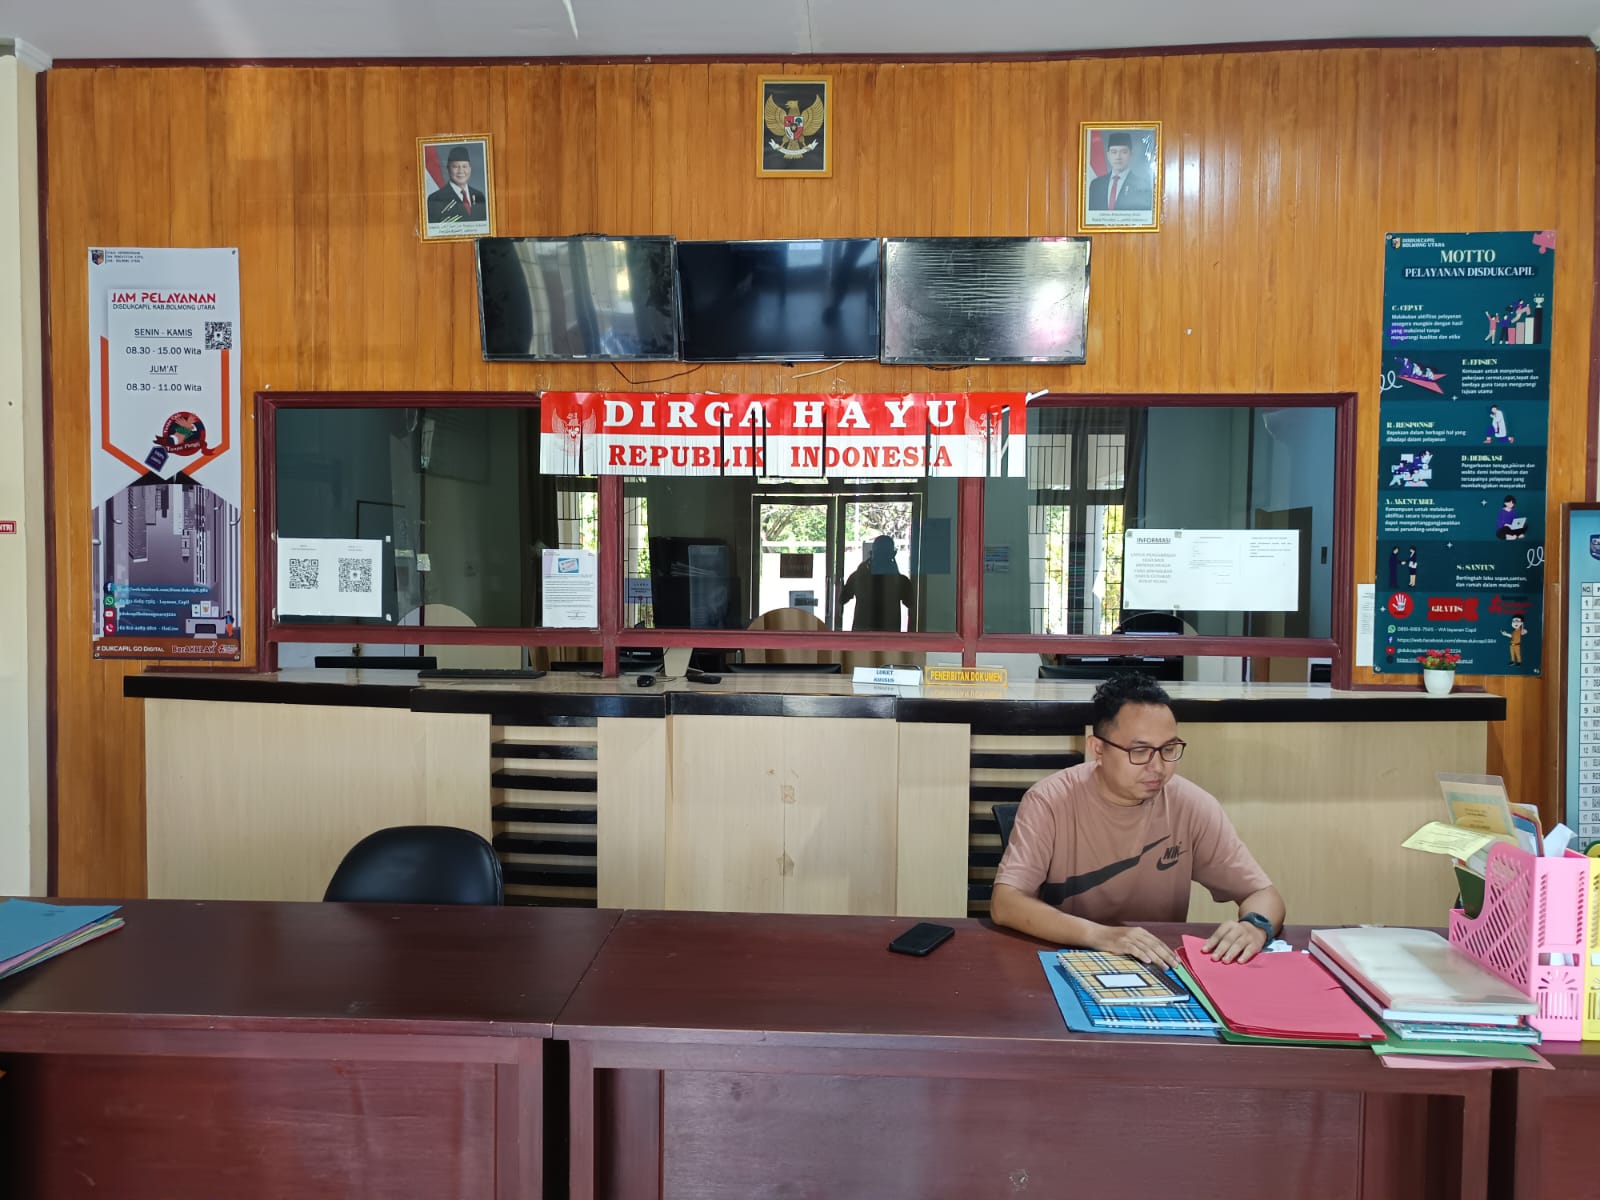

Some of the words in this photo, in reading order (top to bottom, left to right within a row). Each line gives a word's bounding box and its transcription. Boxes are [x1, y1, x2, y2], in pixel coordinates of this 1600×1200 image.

[1440, 250, 1495, 263] MOTTO
[1405, 268, 1465, 277] PELAYANAN
[1467, 267, 1534, 277] DISDUKCAPIL
[112, 292, 136, 303] JAM
[142, 292, 216, 303] PELAYANAN
[158, 347, 181, 355] 15.00
[184, 347, 202, 355] Wita
[126, 383, 151, 391] 08.30
[608, 445, 764, 468] REPUBLIK
[930, 672, 969, 680] PENERBITAN
[970, 672, 1002, 682] DOKUMEN
